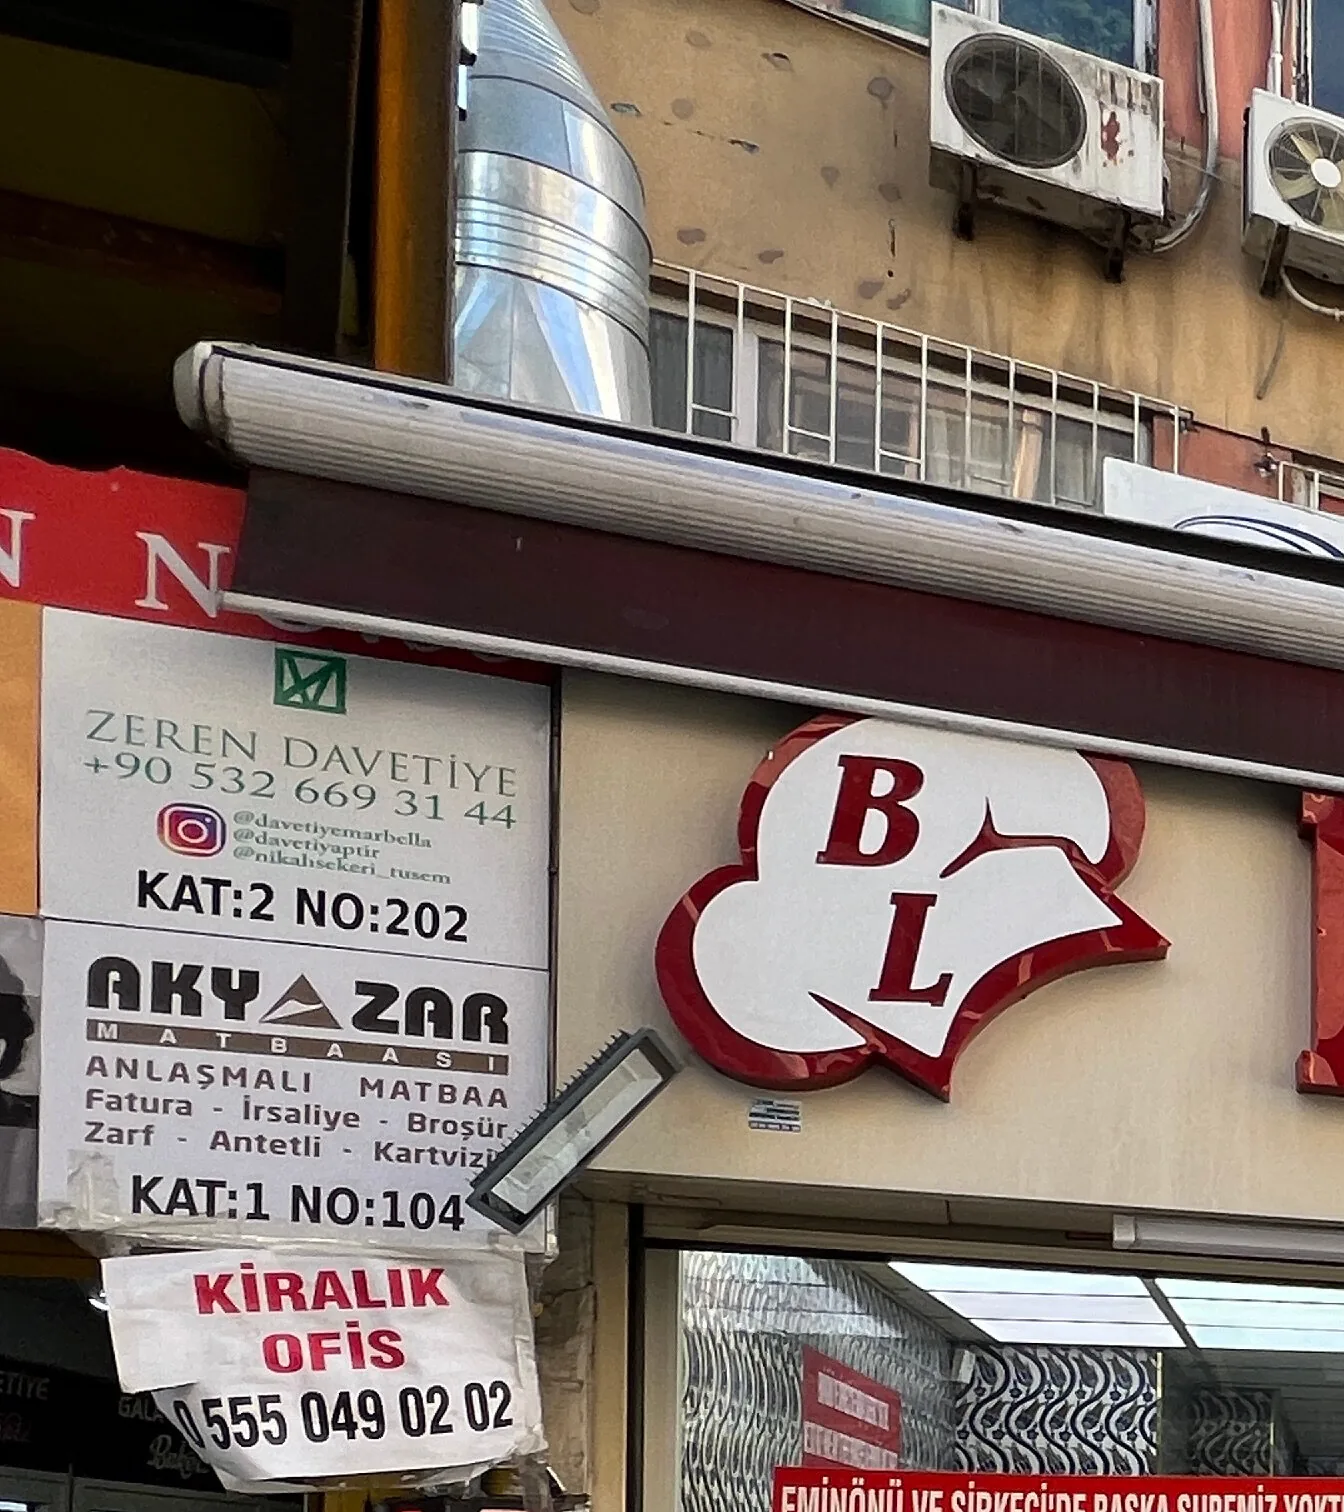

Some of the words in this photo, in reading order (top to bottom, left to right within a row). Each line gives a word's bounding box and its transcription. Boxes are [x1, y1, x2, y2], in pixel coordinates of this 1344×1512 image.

[86, 709, 258, 762] ZEREN
[284, 736, 518, 798] DAVETİYE
[84, 753, 172, 785] +90
[190, 762, 276, 799] 532
[295, 777, 377, 809] 669
[394, 789, 445, 820] 31
[463, 801, 517, 829] 44
[136, 869, 275, 922] KAT:2
[297, 888, 469, 942] NO:202
[95, 1021, 498, 1070] MATBAASI
[85, 1056, 311, 1092] ANLAŞMALI
[360, 1077, 509, 1108] MATBAA
[86, 1089, 193, 1117] Fatura
[243, 1095, 361, 1130] İrsaliye
[407, 1113, 508, 1141] Broşür
[84, 1121, 155, 1146] Zarf
[209, 1130, 321, 1158] Antetli
[374, 1140, 501, 1169] Kartvizi
[131, 1174, 270, 1221] KAT:1
[291, 1184, 465, 1232] NO:104
[193, 1263, 451, 1315] KİRALIK
[262, 1320, 406, 1374] OFİS
[301, 1388, 386, 1443] 049
[399, 1384, 454, 1438] 02
[464, 1380, 514, 1432] 02
